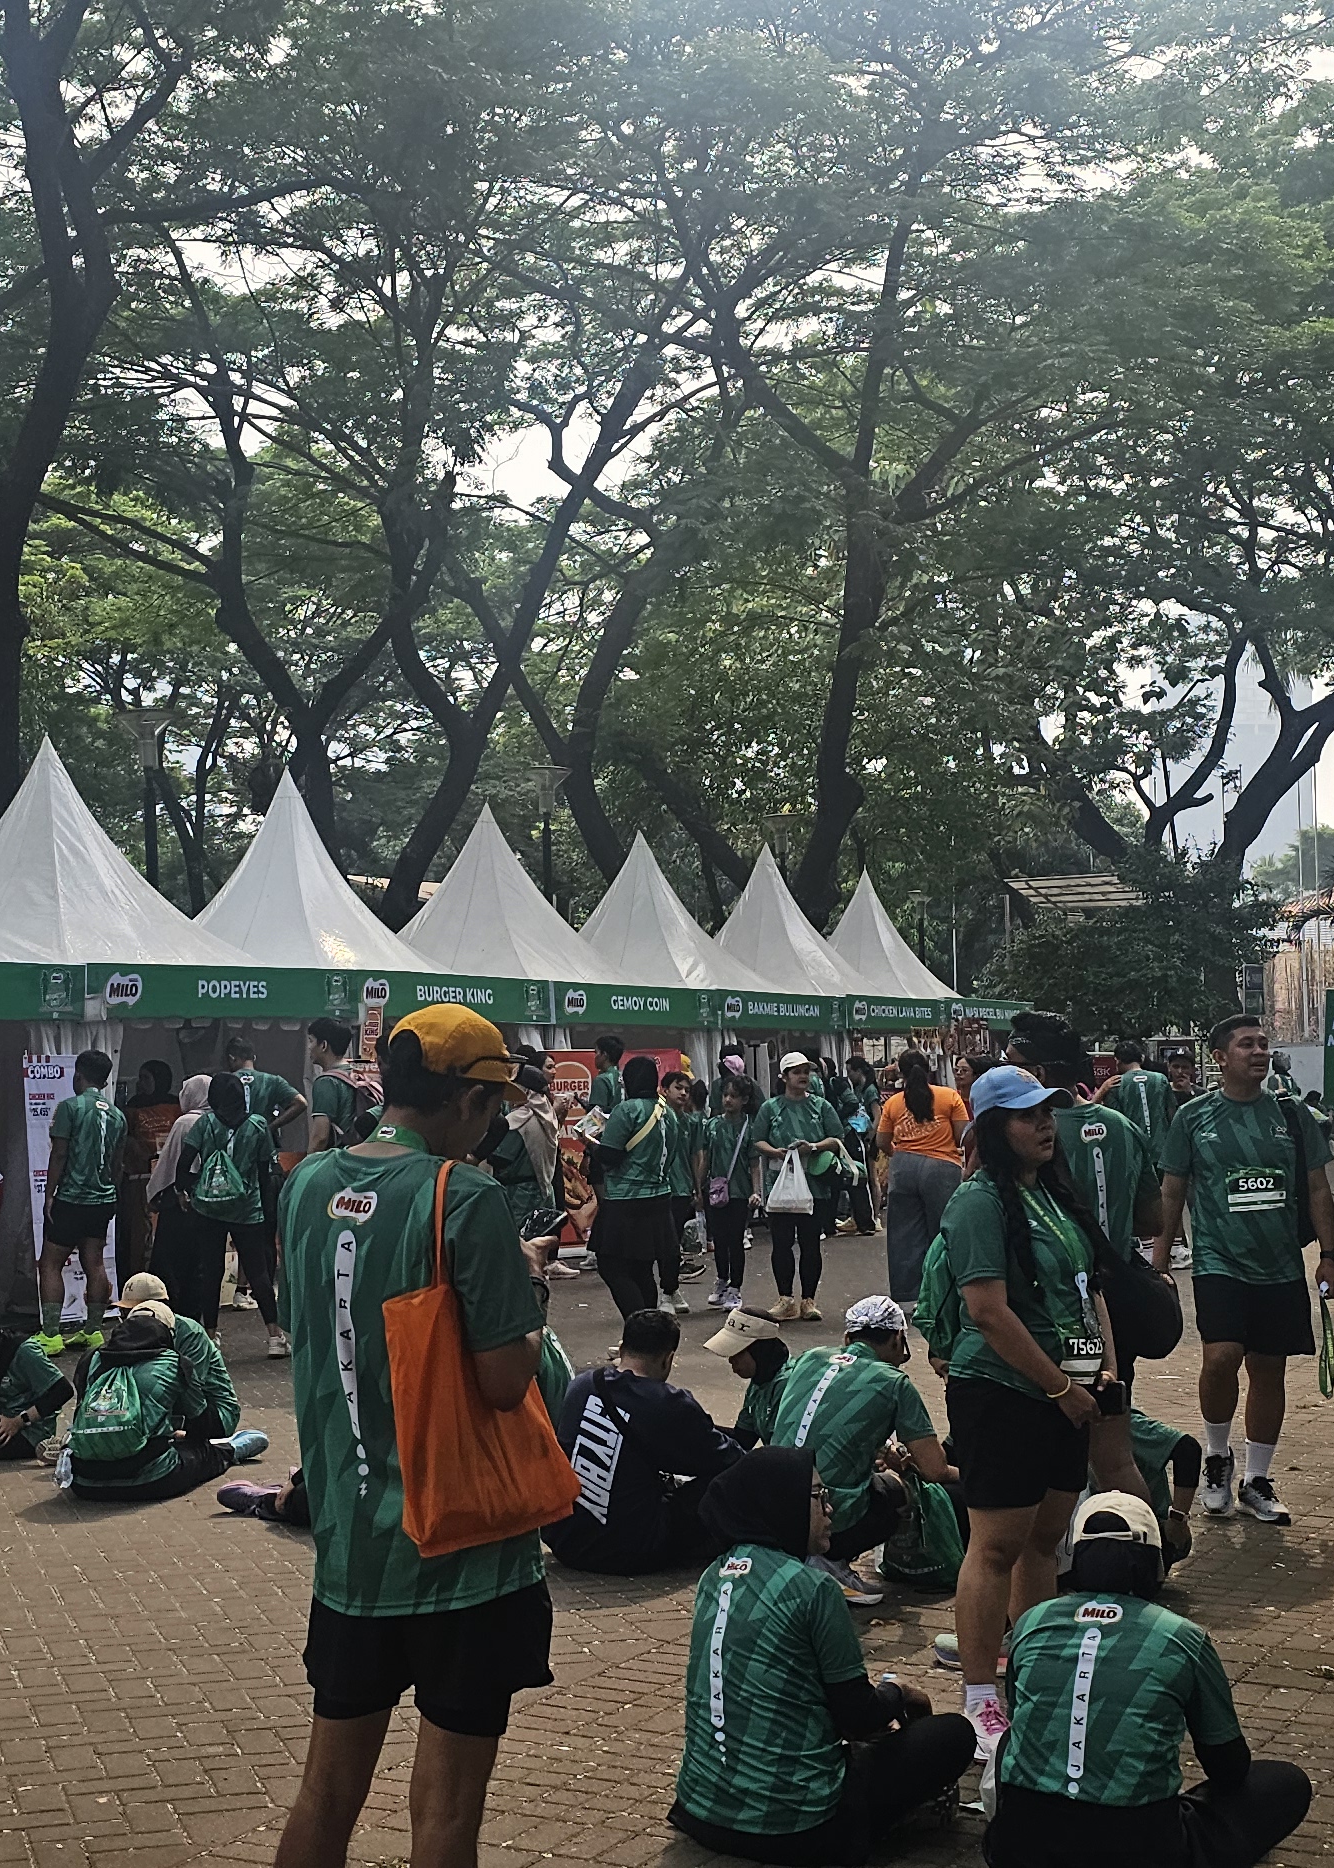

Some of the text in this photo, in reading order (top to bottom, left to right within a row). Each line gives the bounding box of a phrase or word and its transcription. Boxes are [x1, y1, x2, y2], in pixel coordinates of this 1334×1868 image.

[109, 982, 139, 998] MILO
[198, 980, 267, 999] POPEYES
[365, 986, 387, 1000] MILO
[417, 985, 494, 1005] BURGER KING
[567, 996, 585, 1008] MILO
[611, 996, 670, 1012] GEMOY COIN
[748, 1001, 820, 1018] BAKMIE BULUNGAN
[870, 1006, 932, 1019] CHICKEN LAVA BITES
[27, 1065, 62, 1079] COMBO
[550, 1080, 590, 1092] BURGER
[1083, 1128, 1104, 1138] MILO
[1238, 1178, 1275, 1191] 5602
[336, 1195, 373, 1216] MILO
[1081, 1607, 1118, 1619] MILO
[1070, 1634, 1099, 1772] JAKARTA
